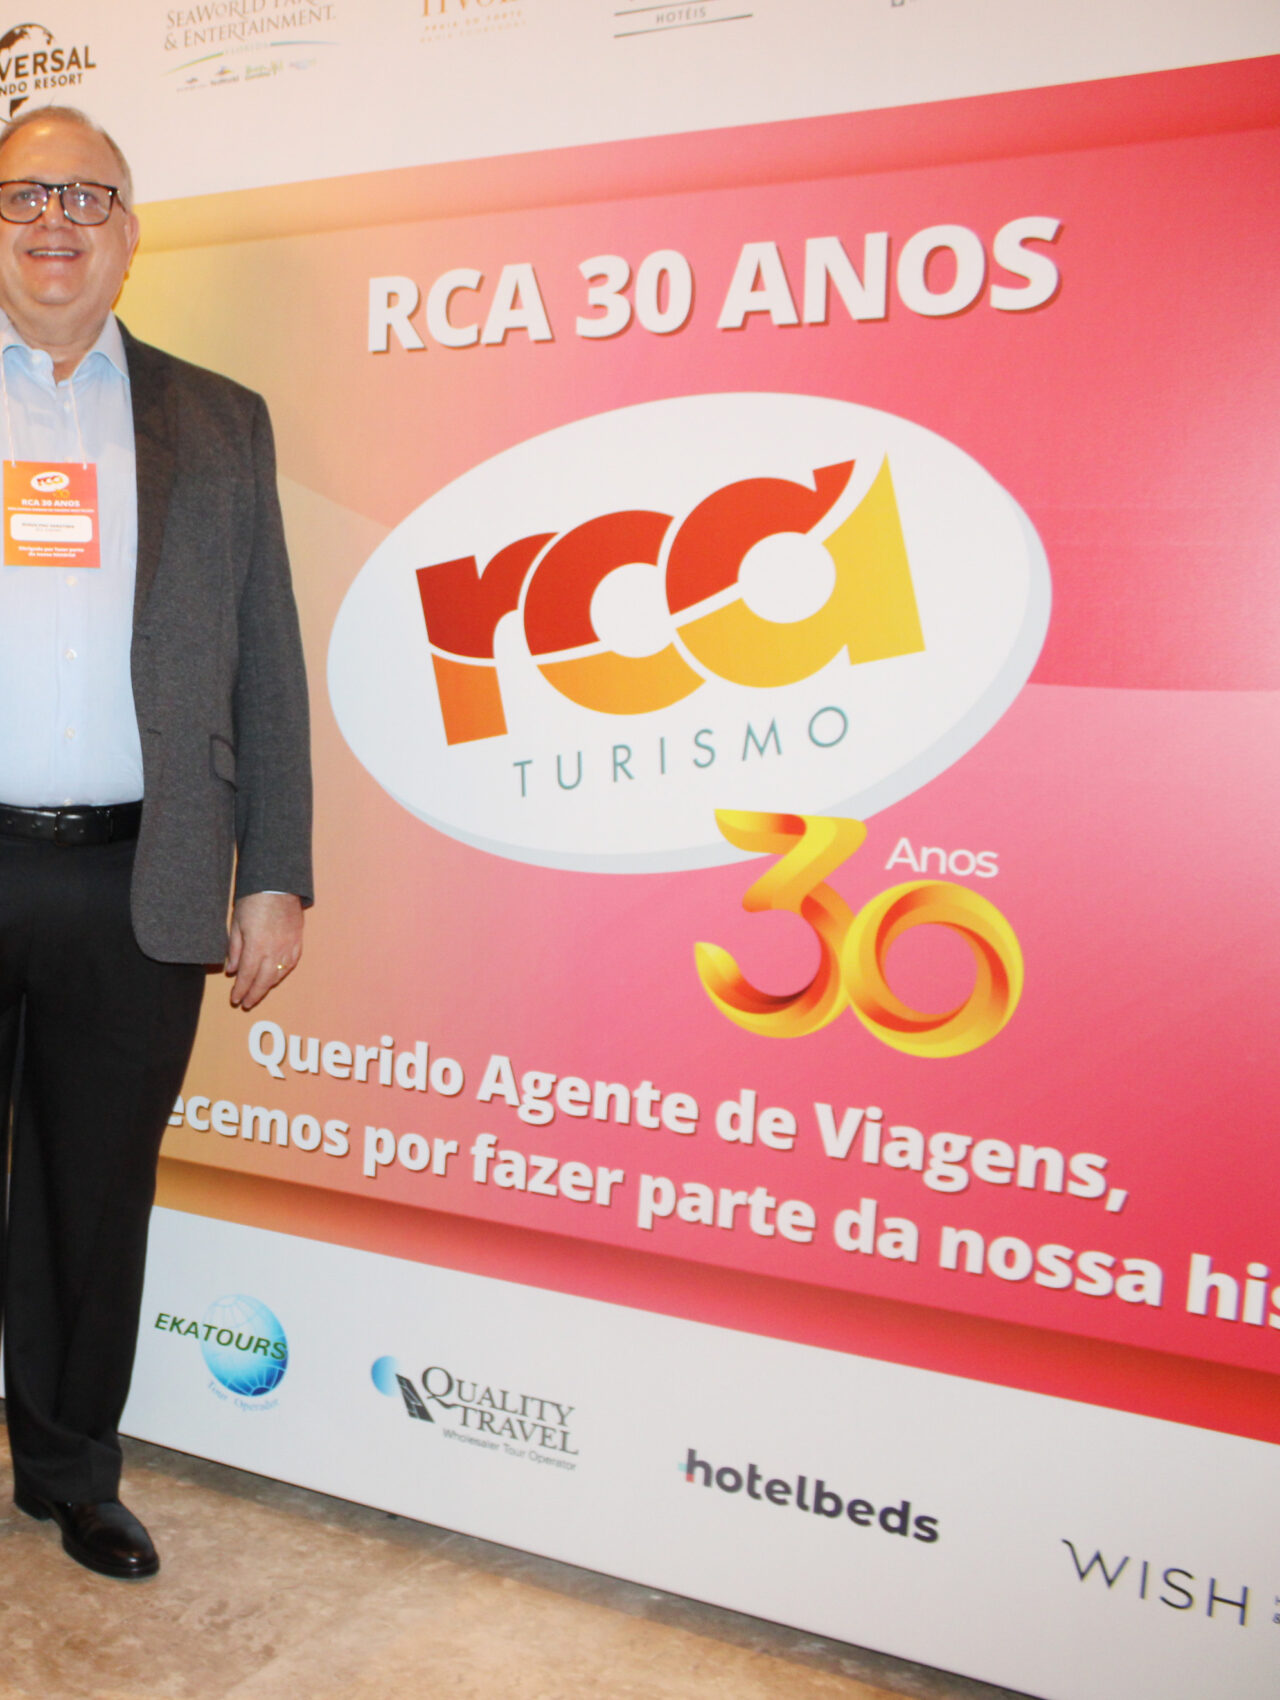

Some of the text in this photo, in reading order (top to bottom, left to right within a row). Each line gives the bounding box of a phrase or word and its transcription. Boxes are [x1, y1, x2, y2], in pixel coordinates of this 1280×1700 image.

[164, 32, 177, 50] &
[34, 73, 83, 90] RESORT
[367, 215, 1063, 353] RCA 30 ANOS
[512, 705, 850, 799] TURISMO
[884, 836, 1000, 879] Anos
[693, 807, 1025, 1059] 30
[247, 1020, 1129, 1214] Querido Agente de Viagens,
[363, 1123, 458, 1178] por
[470, 1133, 626, 1207] fazer
[636, 1174, 817, 1243] parte
[834, 1198, 920, 1263] da
[939, 1225, 1164, 1307] nossa
[154, 1312, 288, 1361] EKATOURS
[421, 1366, 576, 1427] QUALITY
[456, 1404, 580, 1456] TRAVEL
[442, 1428, 577, 1471] Wholesaler Tour Operator
[683, 1447, 940, 1544] hotelbeds
[1061, 1538, 1250, 1627] WISH
